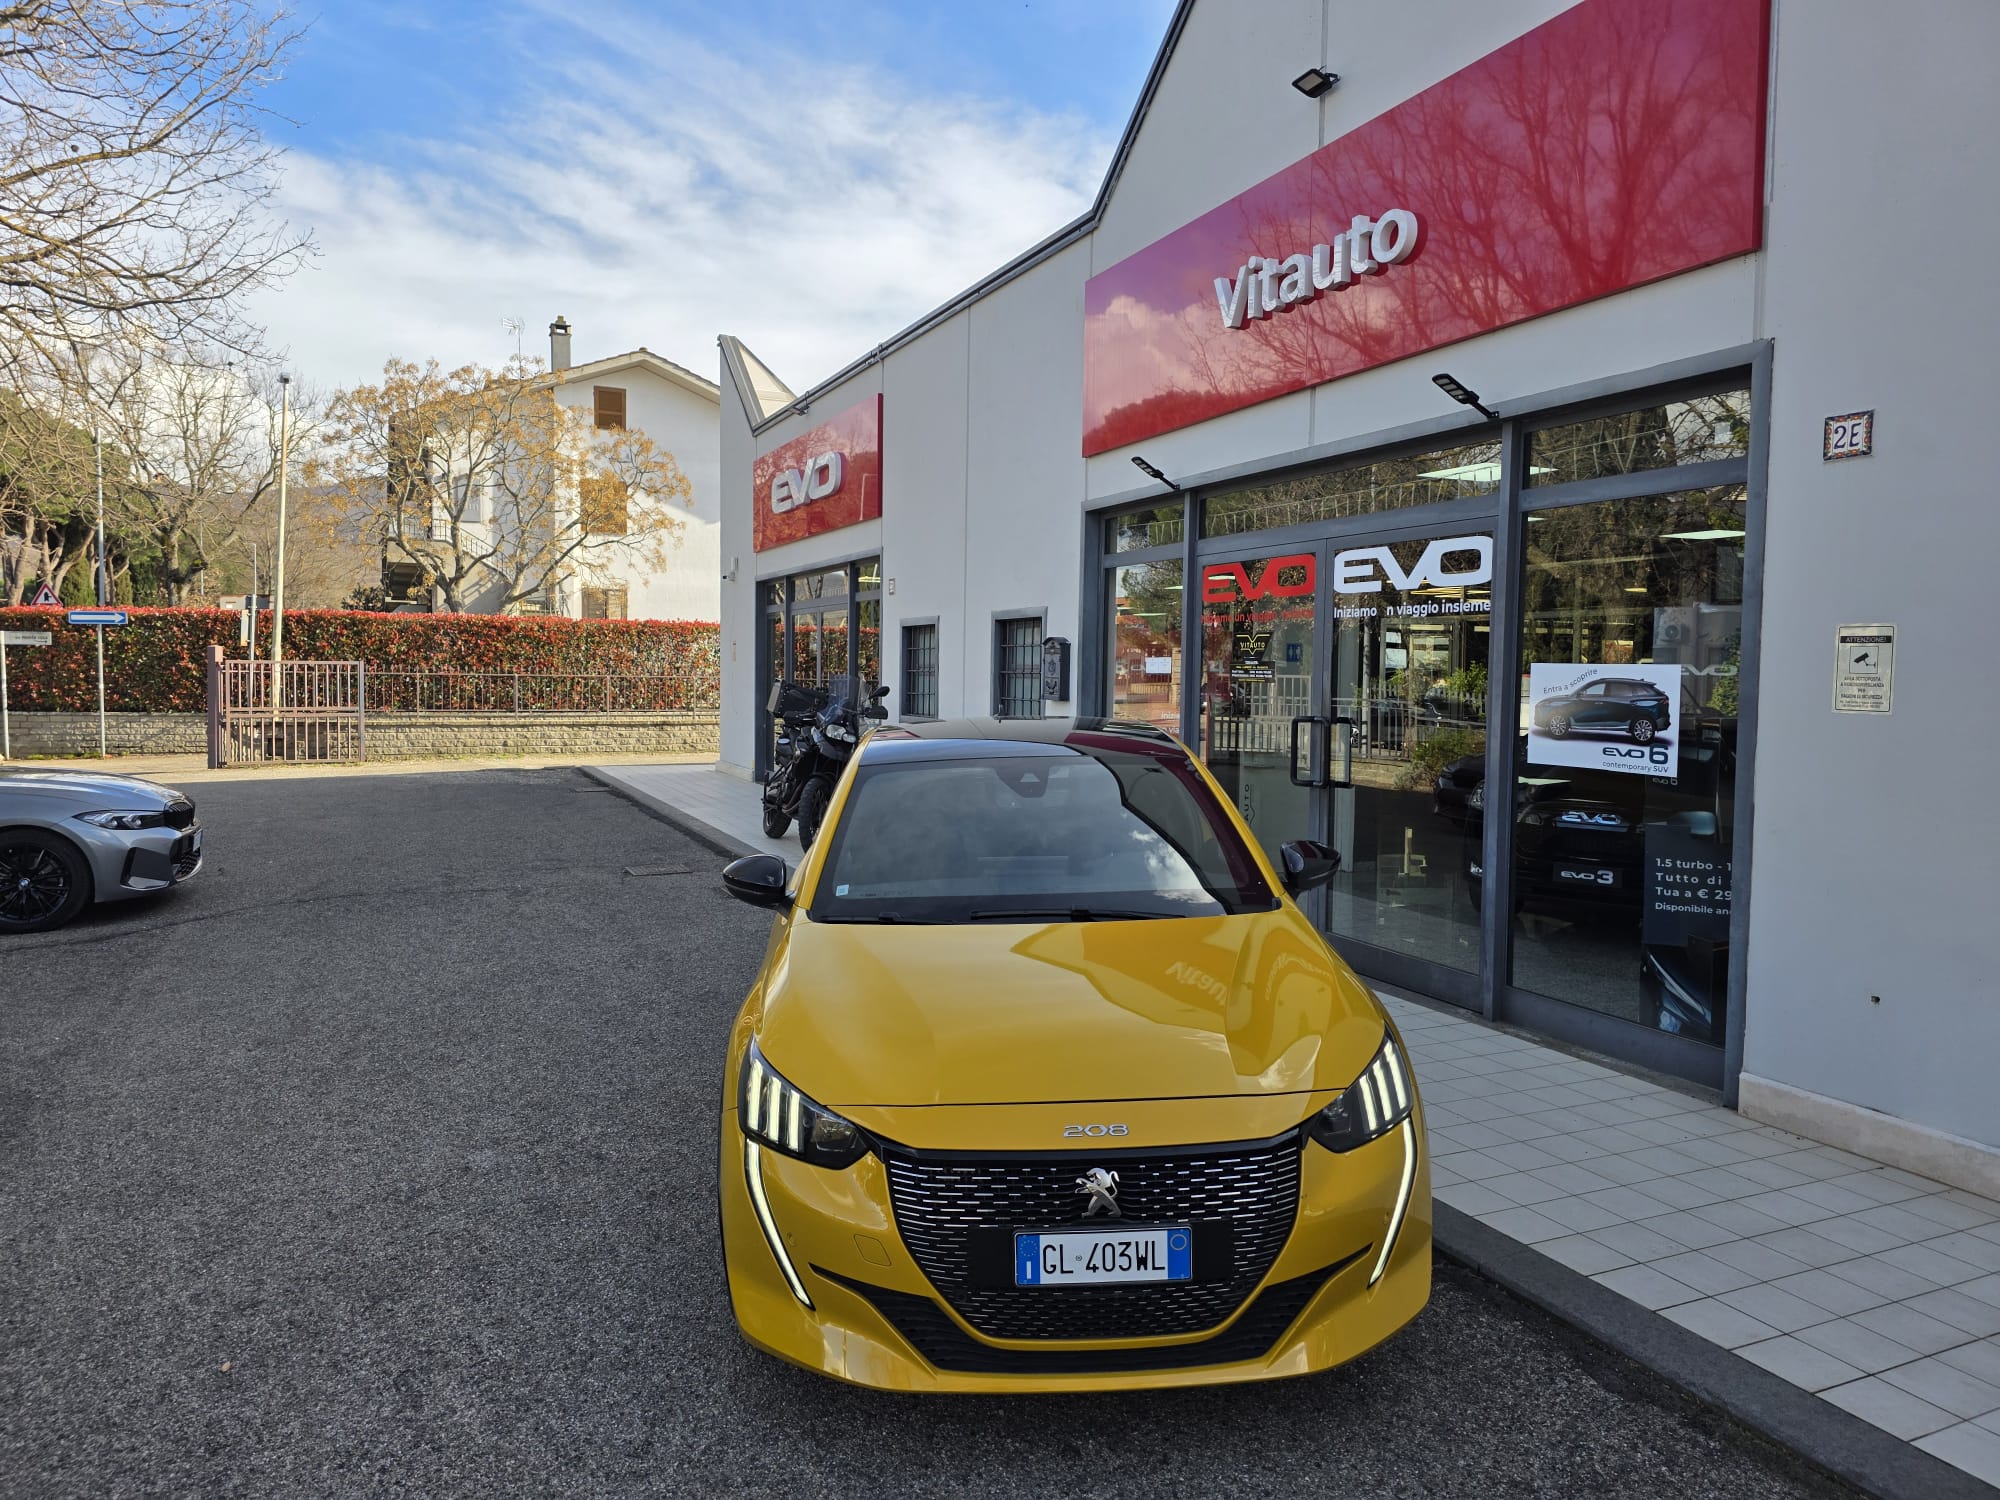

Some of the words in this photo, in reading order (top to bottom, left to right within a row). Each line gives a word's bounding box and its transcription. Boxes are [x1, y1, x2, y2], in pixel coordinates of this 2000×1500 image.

[1213, 208, 1418, 328] Vitauto
[1834, 422, 1861, 449] 2E
[771, 451, 842, 514] EVO
[1334, 535, 1493, 593] EVO
[1202, 553, 1316, 602] EVO
[1334, 606, 1377, 618] Iniziamo
[1397, 601, 1438, 617] viaggio
[1441, 599, 1492, 613] insieme
[1543, 684, 1562, 694] Entra
[1569, 668, 1598, 688] scoprire
[1602, 747, 1645, 758] EVO
[1649, 743, 1669, 764] 6
[1602, 762, 1652, 772] contemporary
[1561, 811, 1622, 825] EVO
[1655, 858, 1673, 867] 1.5
[1676, 860, 1713, 870] turbo
[1561, 870, 1595, 880] EVO
[1596, 869, 1614, 885] 3
[1655, 872, 1699, 884] Tutto
[1707, 875, 1722, 885] di
[1655, 886, 1680, 897] Tua
[1684, 890, 1692, 898] a
[1697, 888, 1709, 899] €
[1655, 902, 1713, 914] Disponibile
[1063, 1124, 1129, 1138] 208
[1042, 1244, 1074, 1274] GL
[1086, 1240, 1166, 1274] 403WL
